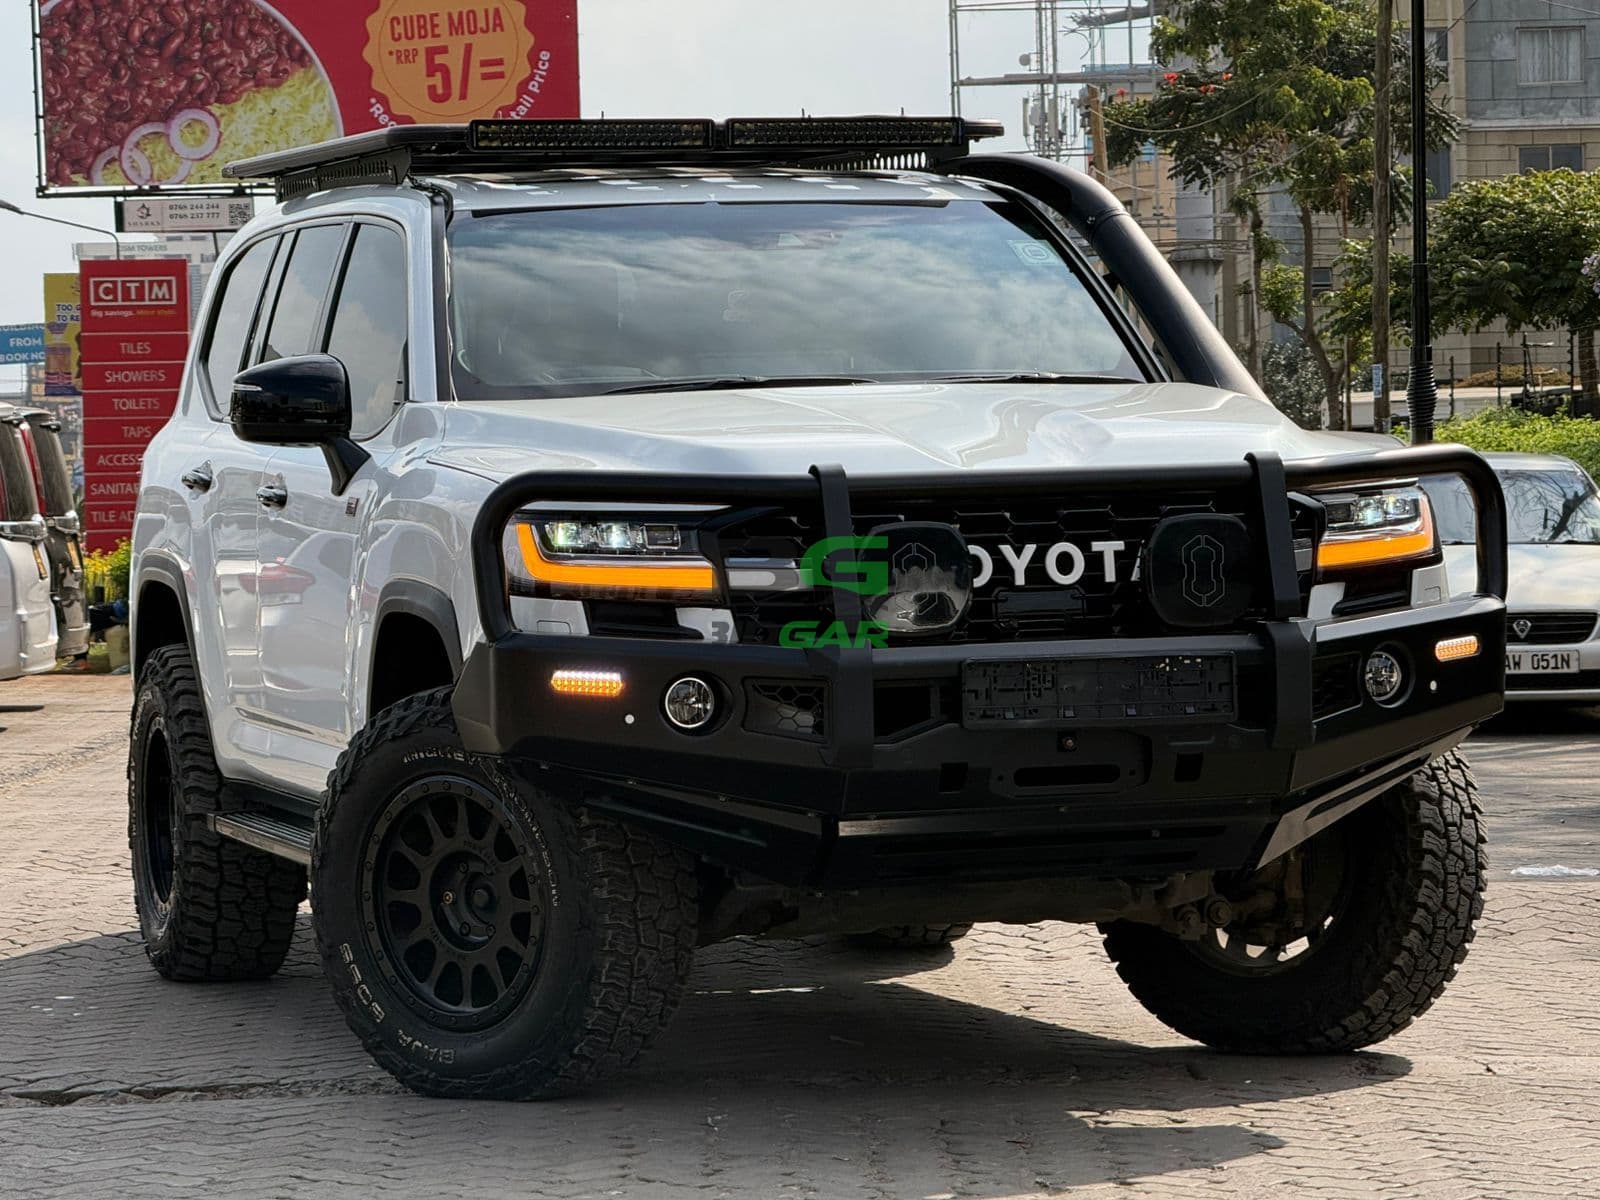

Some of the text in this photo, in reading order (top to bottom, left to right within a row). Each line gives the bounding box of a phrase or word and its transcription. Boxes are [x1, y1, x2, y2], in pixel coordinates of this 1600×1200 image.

[390, 7, 504, 42] CUBE MOJA
[528, 50, 550, 93] Price
[98, 281, 171, 300] CTM
[9, 337, 42, 347] FROM
[120, 342, 152, 355] TILES
[105, 370, 166, 383] SHOWERS
[112, 398, 160, 411] TOILETS
[121, 426, 152, 438] TAPS
[90, 510, 116, 522] TILE
[967, 541, 1141, 588] OYOT
[1531, 653, 1570, 670] 051N
